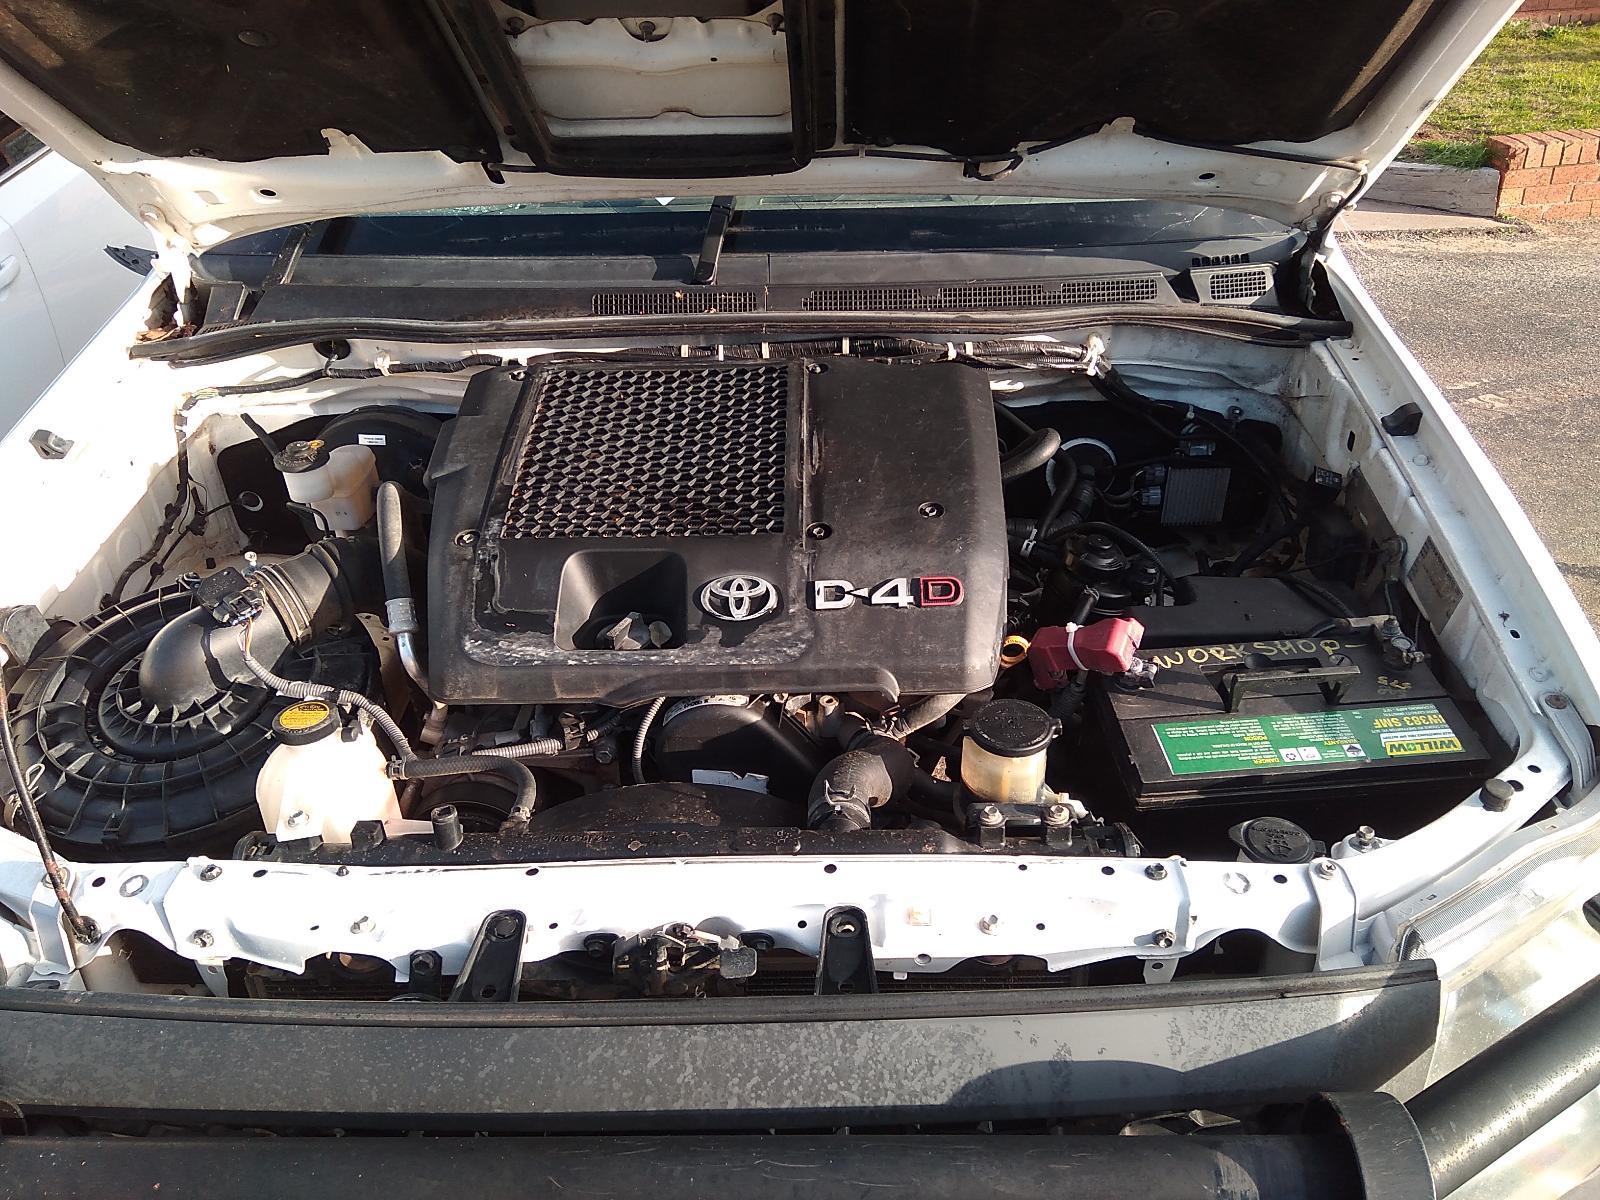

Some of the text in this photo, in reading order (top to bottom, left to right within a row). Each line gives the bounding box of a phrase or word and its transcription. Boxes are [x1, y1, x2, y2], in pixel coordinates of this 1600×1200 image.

[814, 576, 965, 610] D-4D
[1373, 717, 1401, 728] SMF
[1389, 739, 1457, 753] WILLOW
